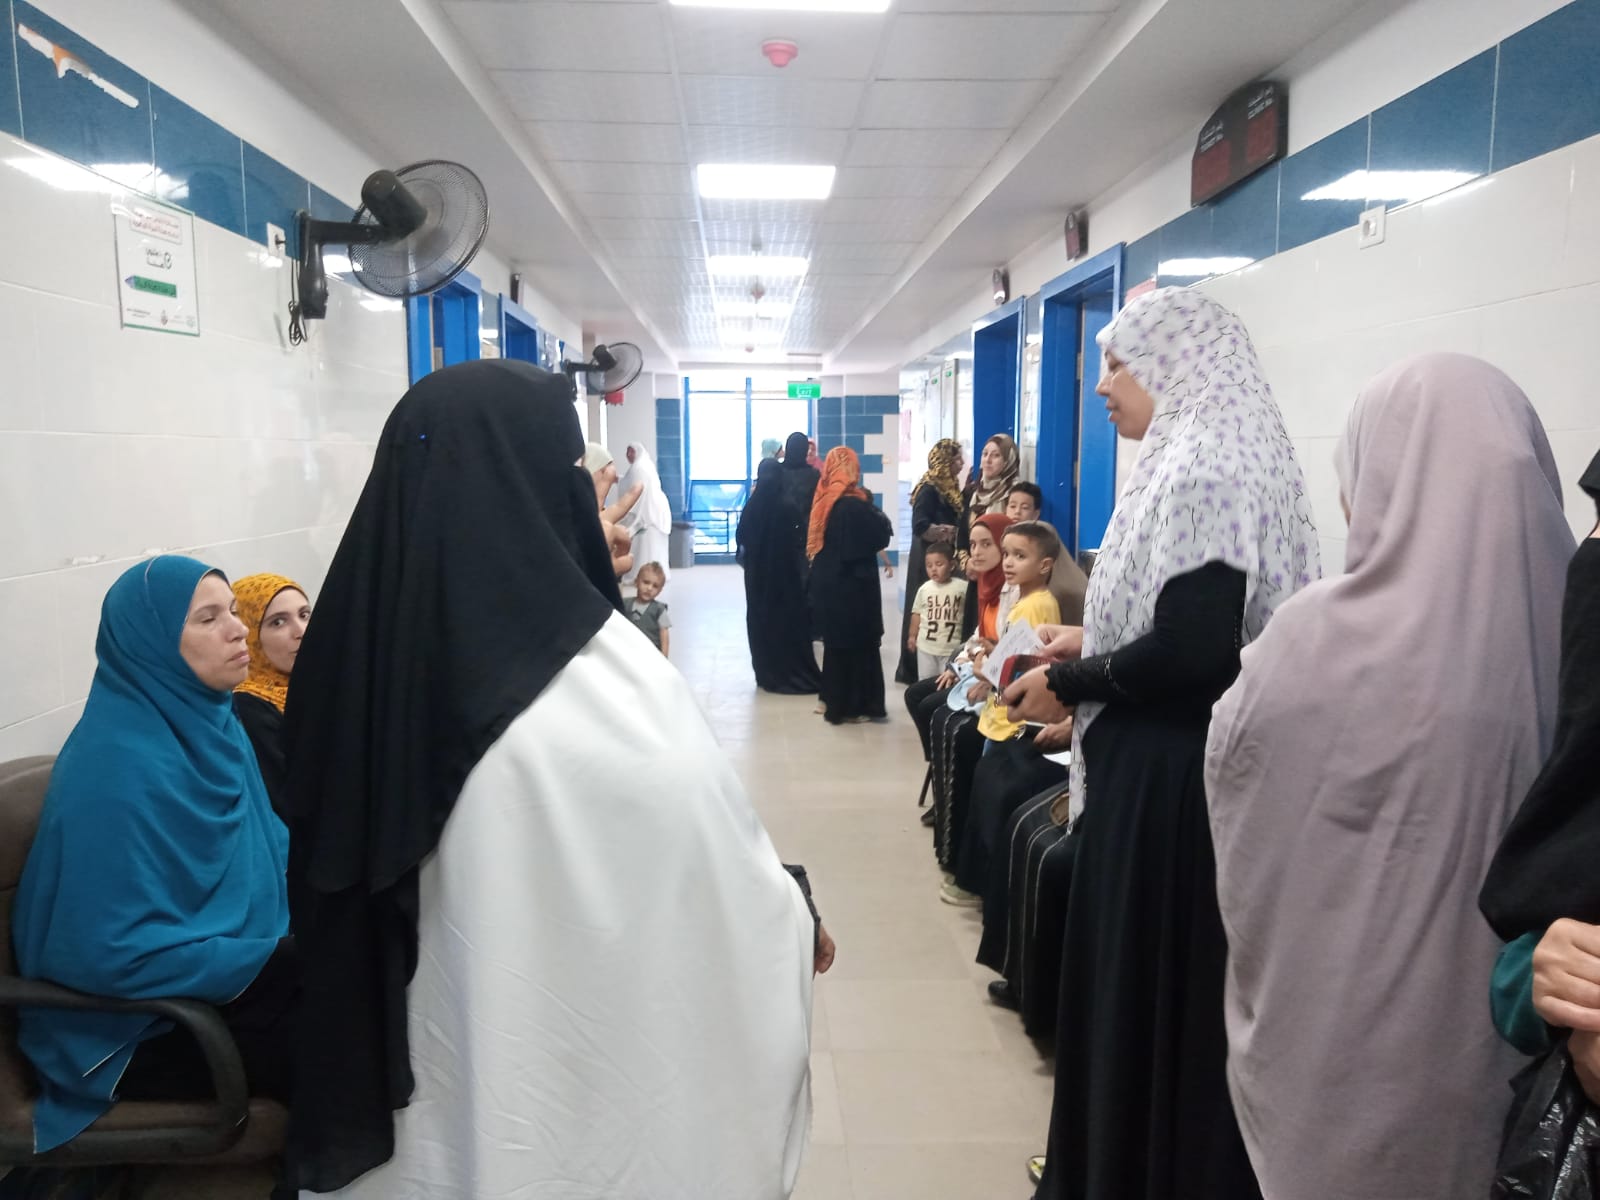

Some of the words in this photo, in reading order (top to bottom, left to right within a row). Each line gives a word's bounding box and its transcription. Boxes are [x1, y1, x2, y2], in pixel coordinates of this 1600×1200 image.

[927, 594, 961, 608] SLAM
[927, 607, 960, 621] DUNK
[926, 621, 956, 643] 27
